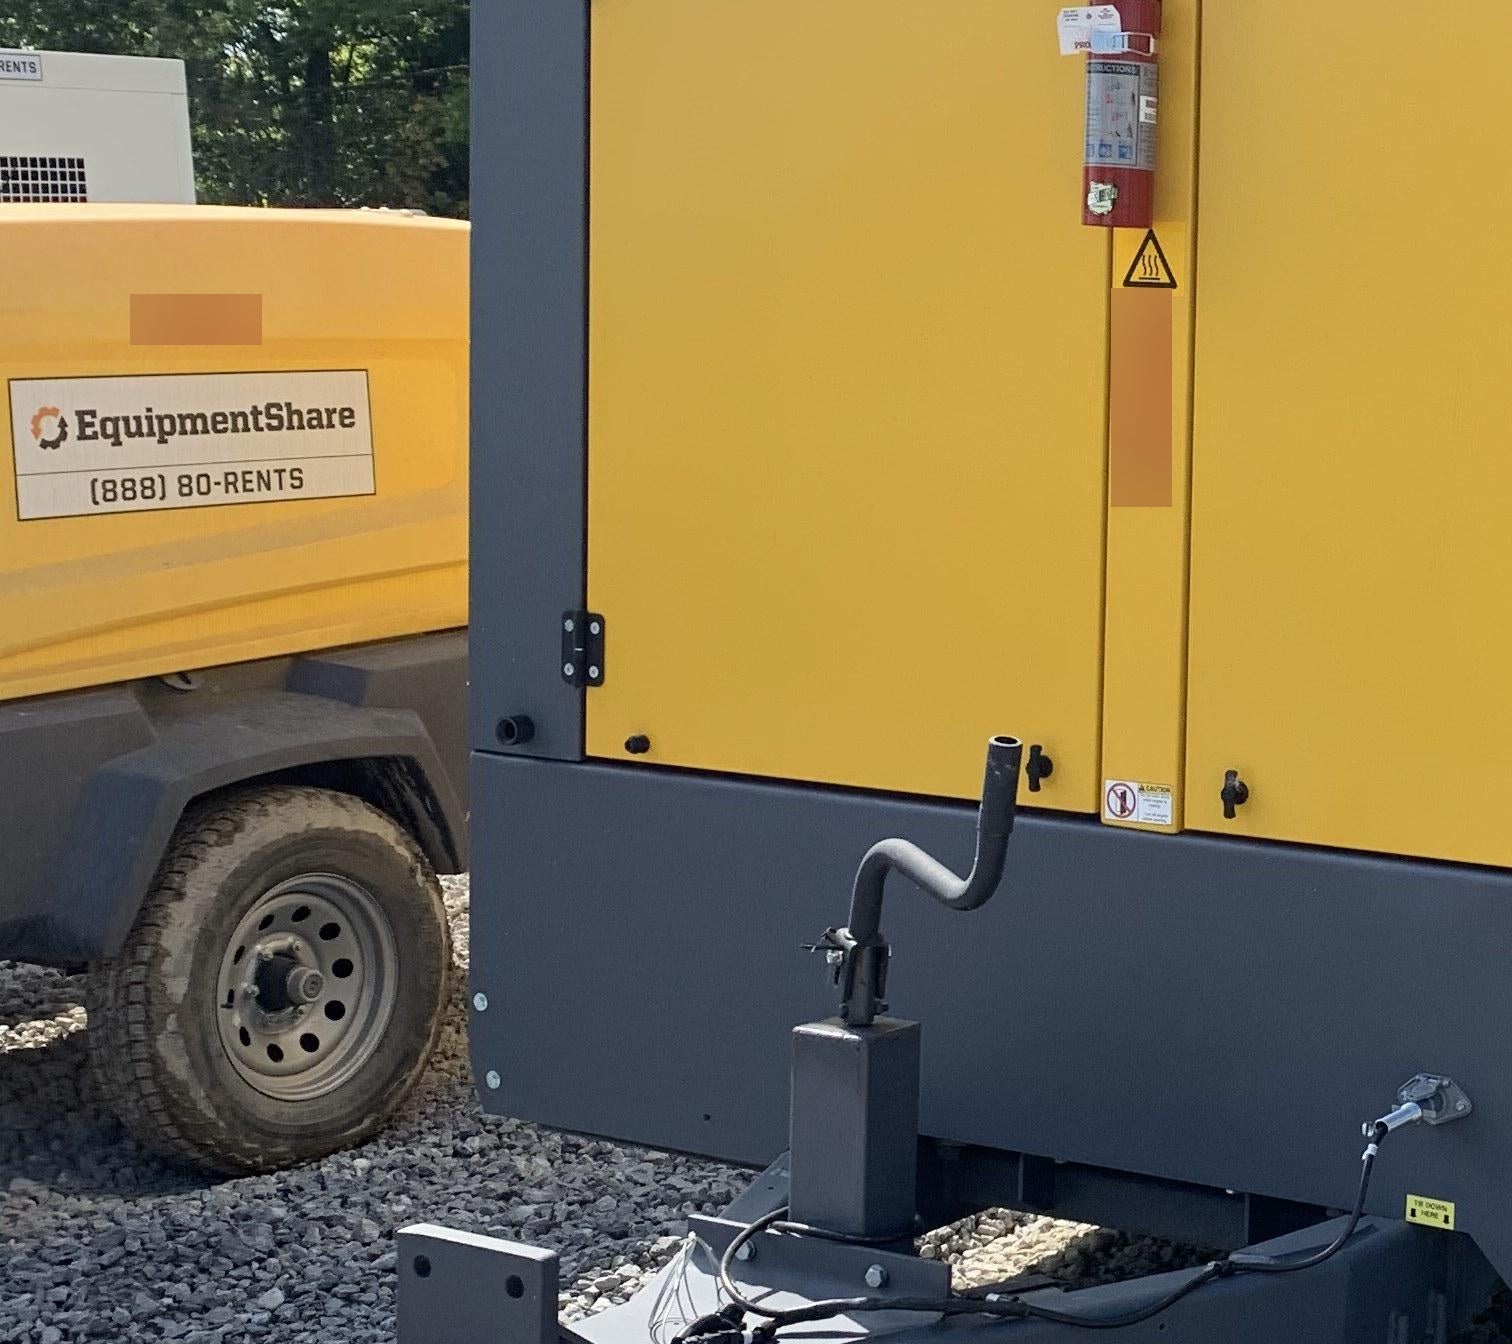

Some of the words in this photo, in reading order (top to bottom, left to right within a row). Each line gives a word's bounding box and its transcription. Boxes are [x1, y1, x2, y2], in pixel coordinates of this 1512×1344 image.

[75, 402, 356, 446] EquipmentShare
[90, 476, 167, 505] (888)
[178, 468, 304, 498] 80-RENTS
